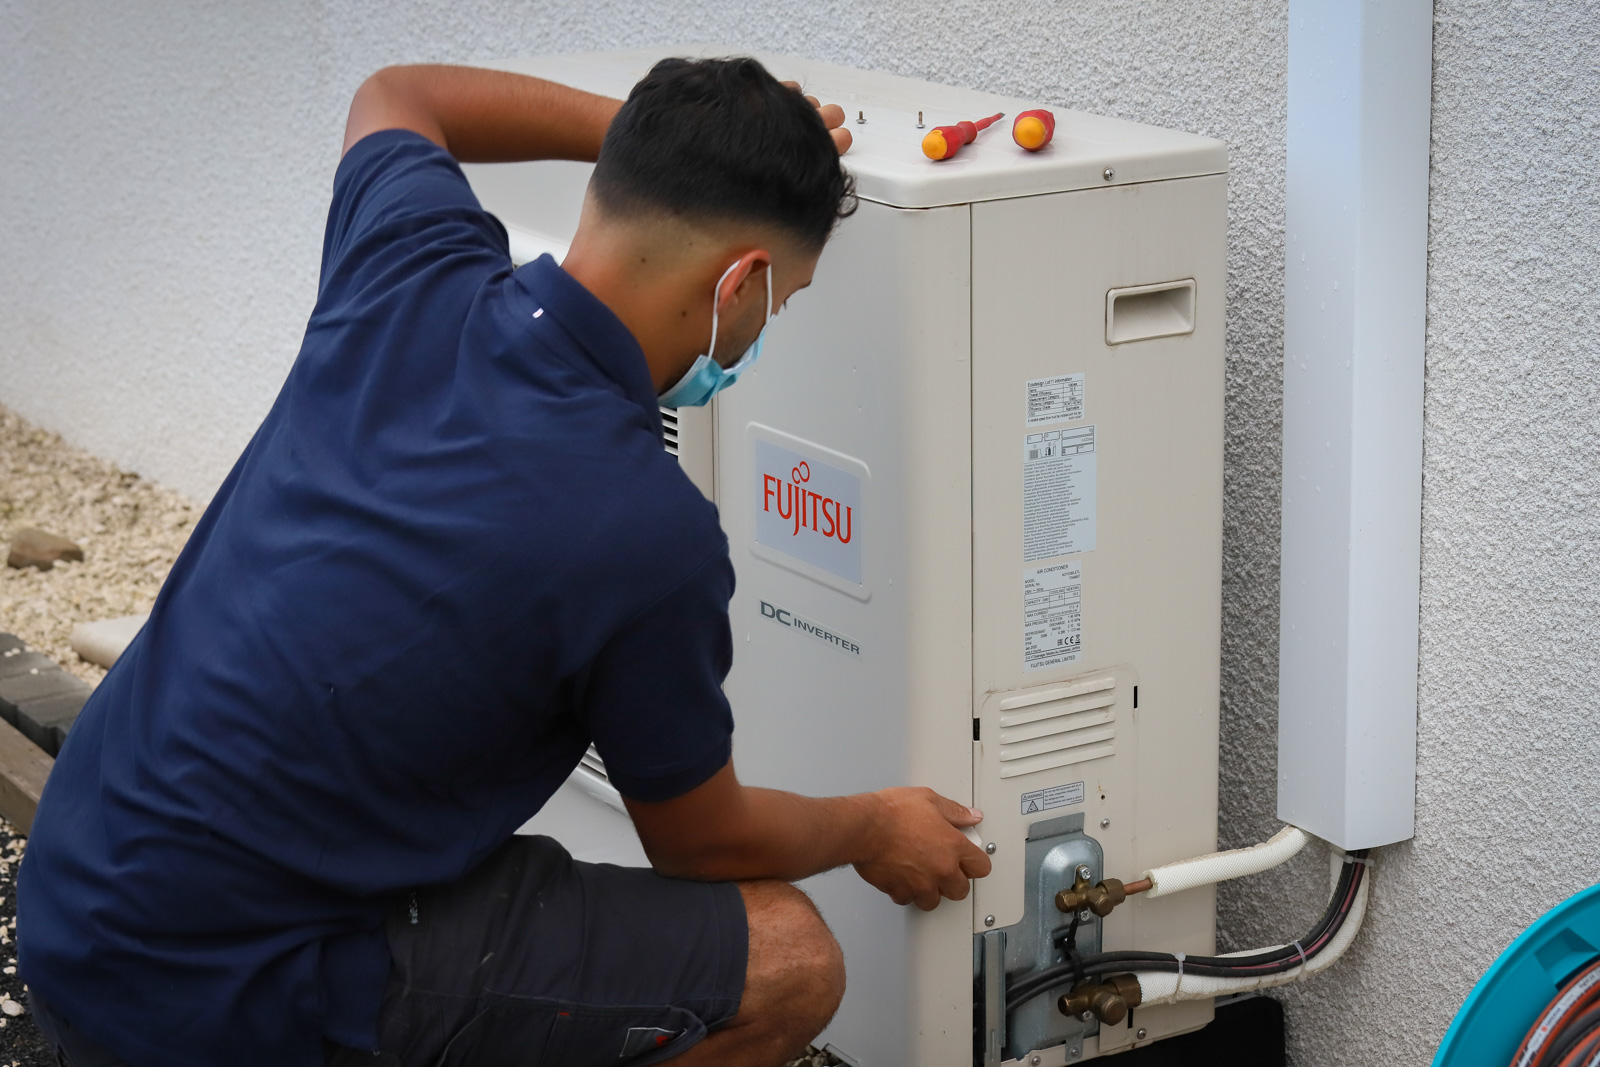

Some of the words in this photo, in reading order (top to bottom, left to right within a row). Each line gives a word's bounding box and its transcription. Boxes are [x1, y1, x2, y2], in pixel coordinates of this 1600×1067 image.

[763, 473, 852, 544] FUJITSU
[1044, 564, 1068, 573] CONDITIONER
[760, 600, 791, 627] DC
[794, 618, 860, 655] INVERTER
